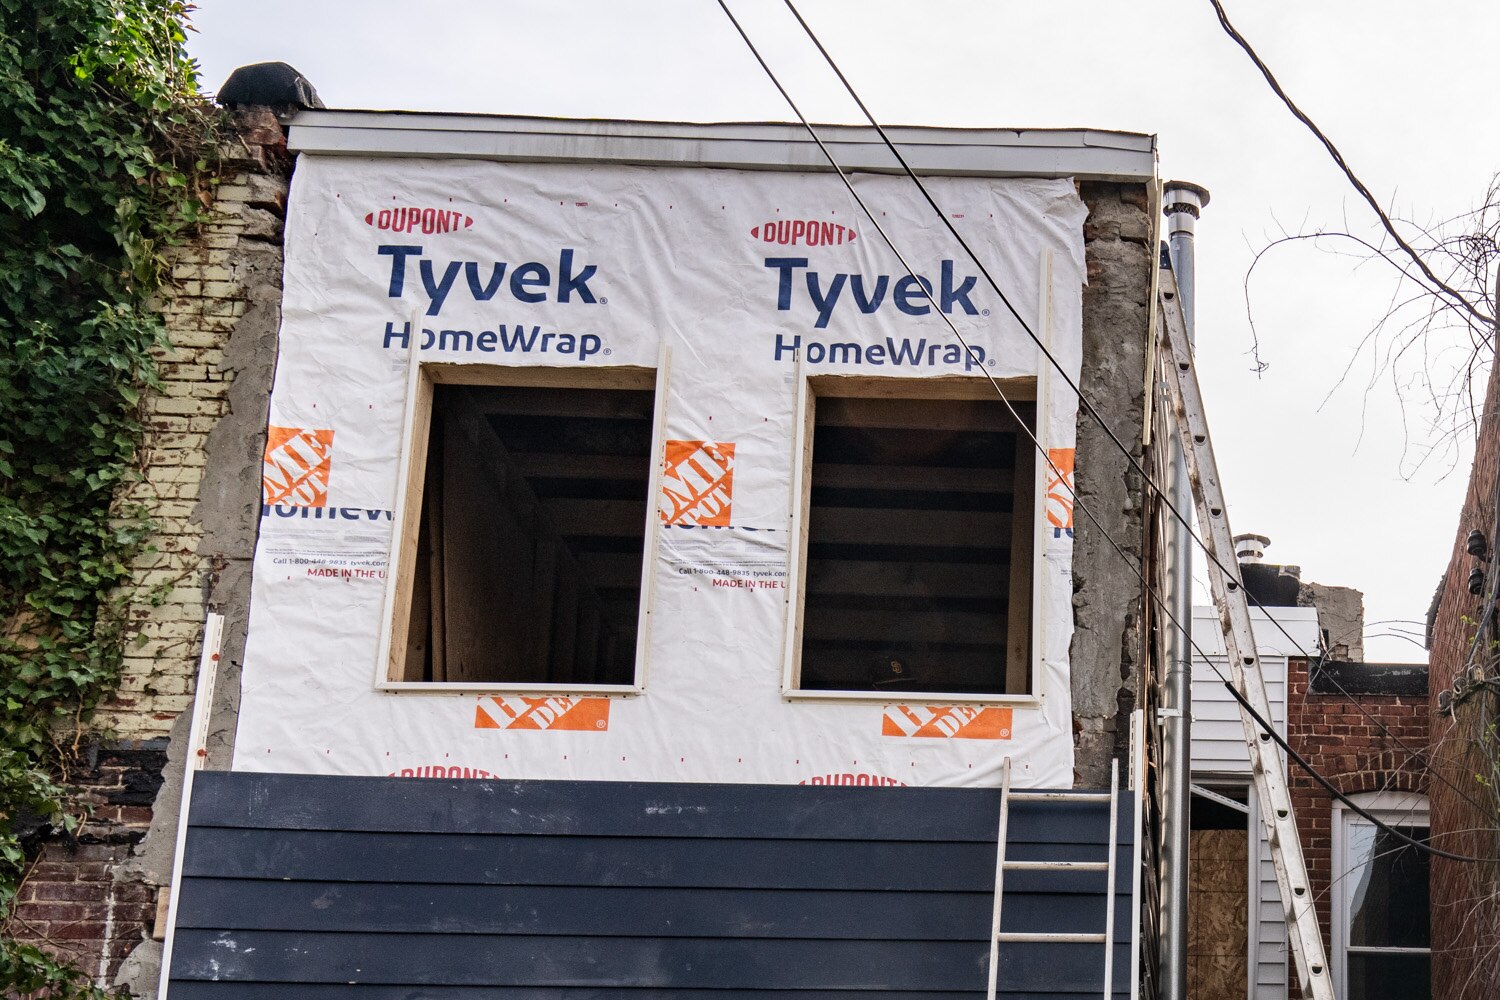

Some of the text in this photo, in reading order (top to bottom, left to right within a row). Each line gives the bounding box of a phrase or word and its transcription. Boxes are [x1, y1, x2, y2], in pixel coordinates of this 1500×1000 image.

[377, 207, 463, 235] DUPONT
[763, 220, 846, 247] DUPONT
[377, 244, 598, 316] Tyvek
[764, 257, 980, 329] Tyvek
[383, 321, 602, 361] HomeWrap
[774, 333, 987, 371] HomeWrap
[307, 568, 339, 578] MADE
[341, 569, 352, 578] IN
[355, 569, 376, 578] THE
[679, 567, 692, 575] Call
[712, 579, 744, 588] MADE
[745, 580, 756, 588] IN
[758, 580, 779, 589] THE
